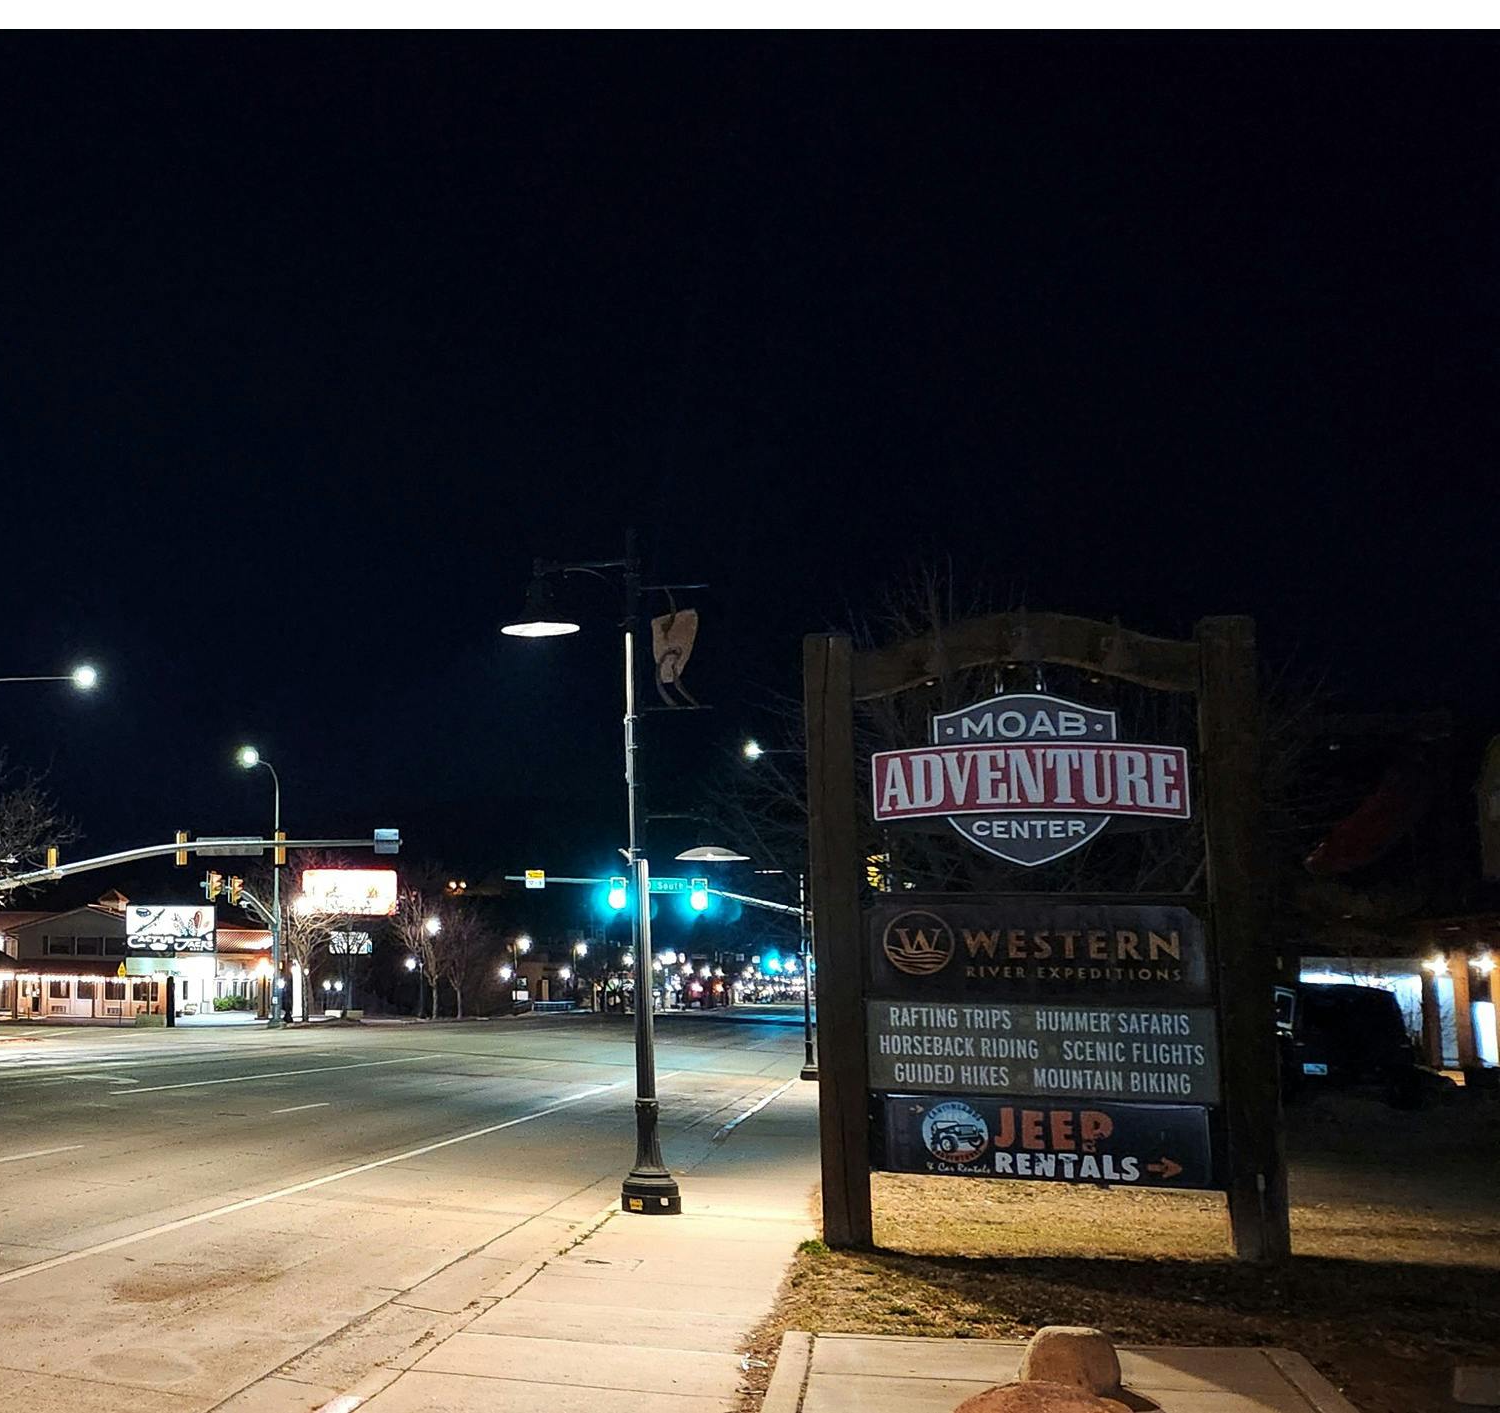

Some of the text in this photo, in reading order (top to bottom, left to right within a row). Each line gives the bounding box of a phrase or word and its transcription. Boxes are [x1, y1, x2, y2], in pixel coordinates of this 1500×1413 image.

[961, 710, 1088, 739] MOAB
[878, 748, 1182, 812] ADVENTURE
[971, 820, 1087, 839] CENTER
[962, 929, 1181, 961] WESTERN
[966, 965, 1182, 981] RIVER EXPEDITIONS
[889, 1006, 958, 1028] RAFTING
[964, 1008, 1012, 1030] TRIPS
[1117, 1012, 1190, 1036] SAFARIS
[879, 1035, 1205, 1066] HORSEBACK RIDING SCENIC FLIGHTS
[894, 1062, 1191, 1095] GUIDED HIKES MOUNTAIN BIKING
[994, 1106, 1115, 1151] JEEP
[994, 1152, 1140, 1182] RENTALS
